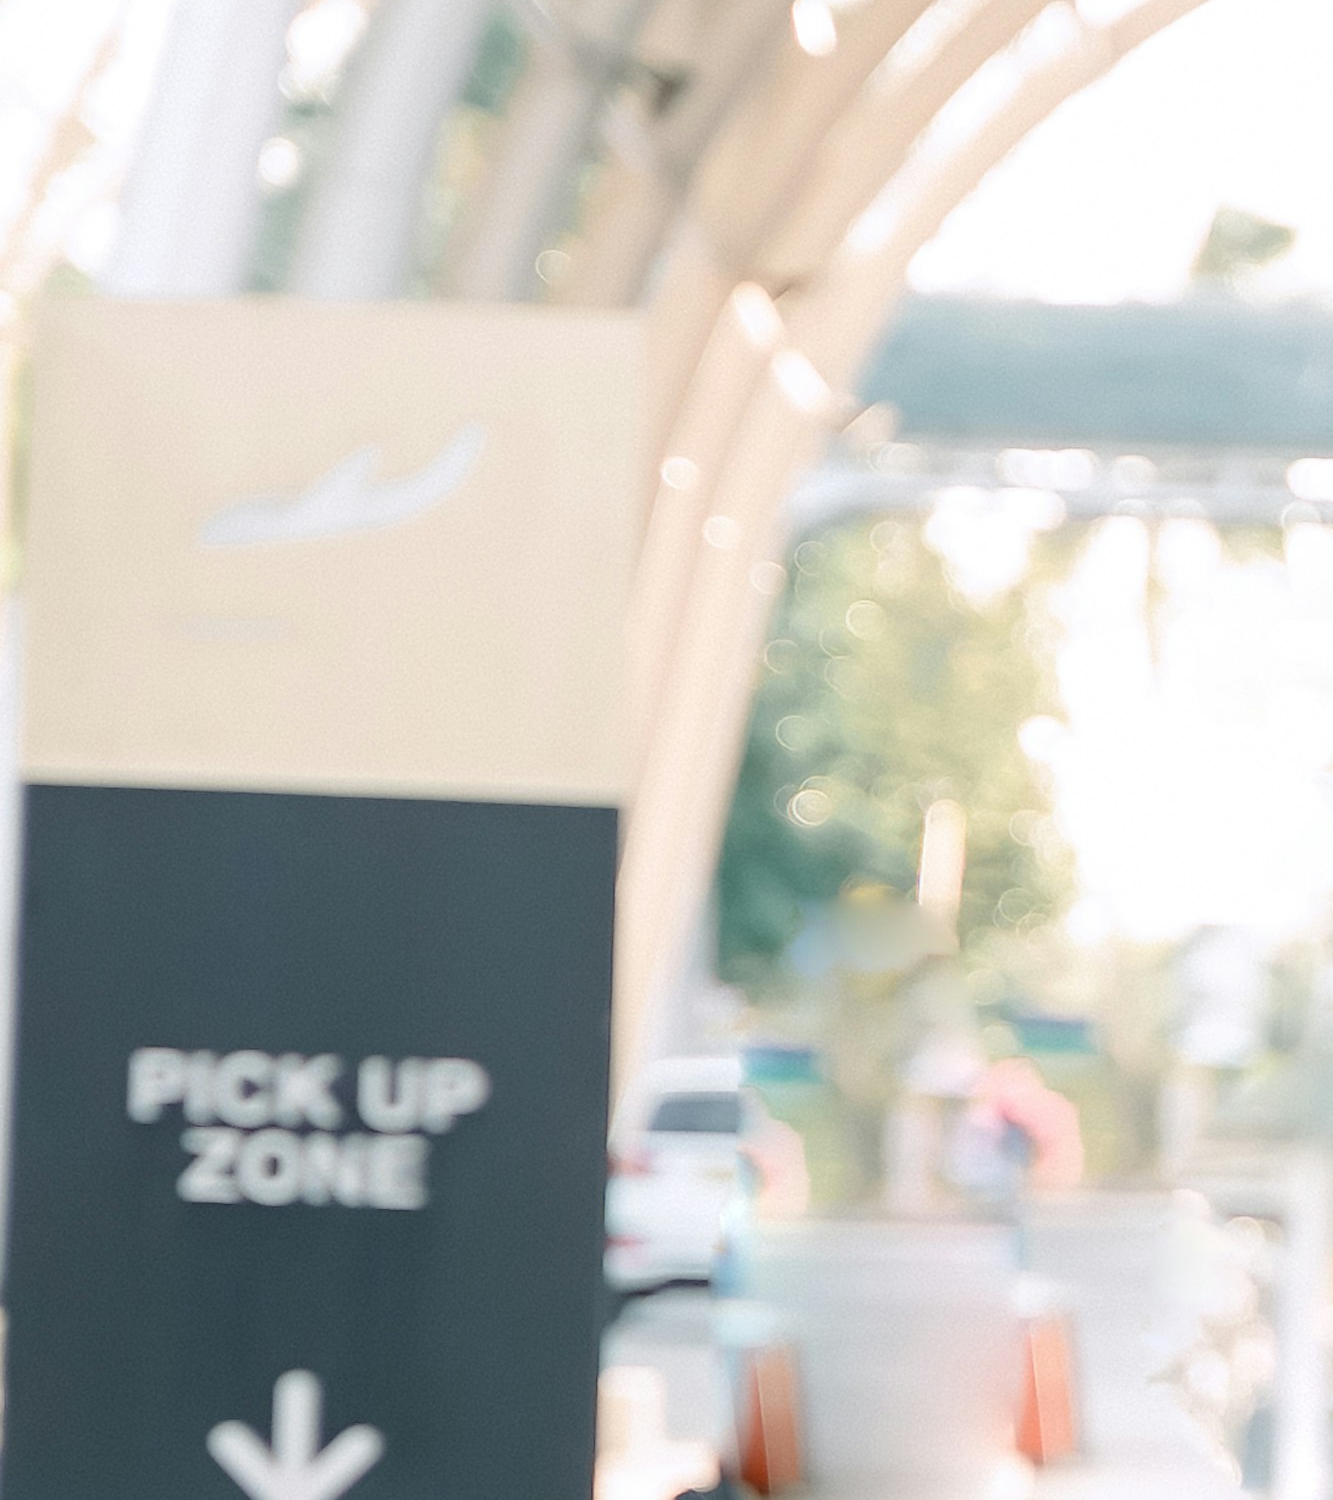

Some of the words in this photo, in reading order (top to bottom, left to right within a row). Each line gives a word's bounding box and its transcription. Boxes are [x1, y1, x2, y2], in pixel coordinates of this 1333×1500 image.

[129, 1048, 344, 1128] PICK
[358, 1055, 489, 1133] UP
[177, 1129, 430, 1209] ZONE
